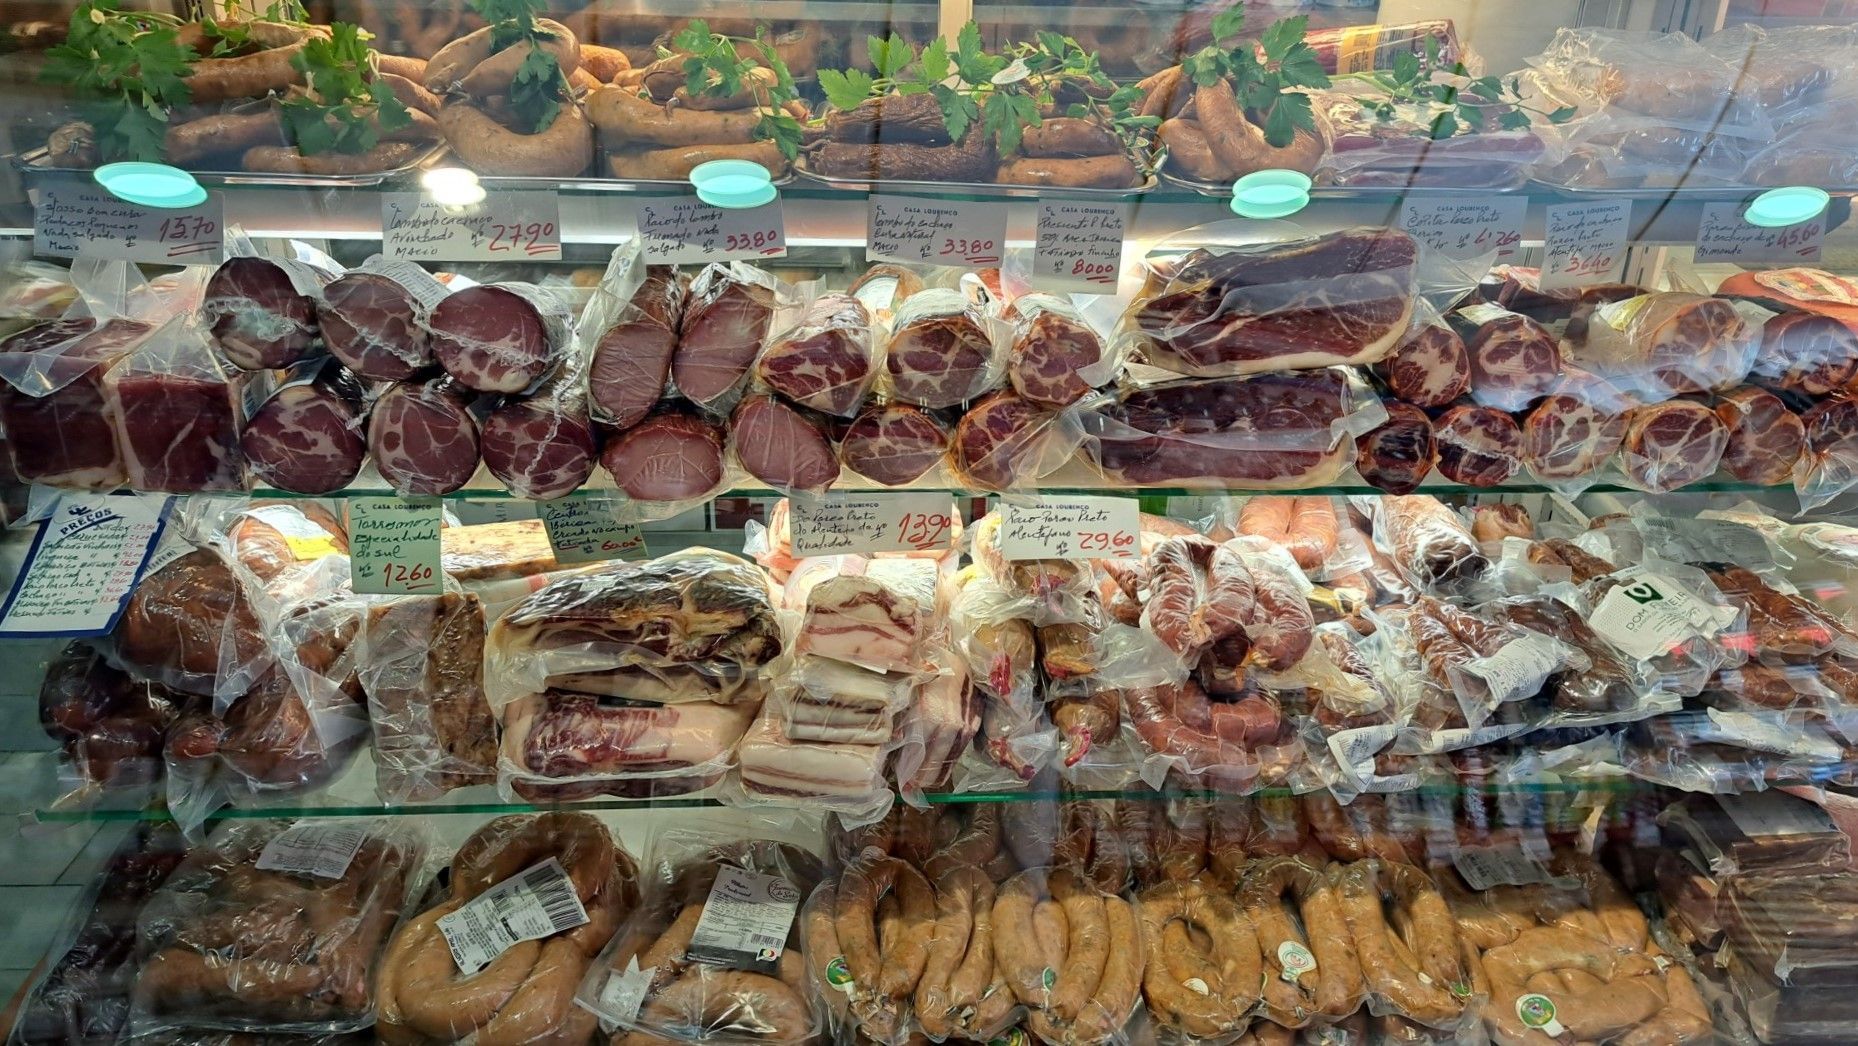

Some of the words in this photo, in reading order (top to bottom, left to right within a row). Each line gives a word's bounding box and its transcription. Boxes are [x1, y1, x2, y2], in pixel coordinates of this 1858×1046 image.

[904, 206, 921, 214] CASA
[488, 222, 554, 252] 27.90
[724, 230, 777, 252] 33.80
[940, 238, 994, 255] 33.80
[60, 507, 113, 536] PREÇOS
[898, 512, 951, 544] 13.90
[1077, 530, 1134, 551] 29.60
[384, 562, 432, 587] 12.60
